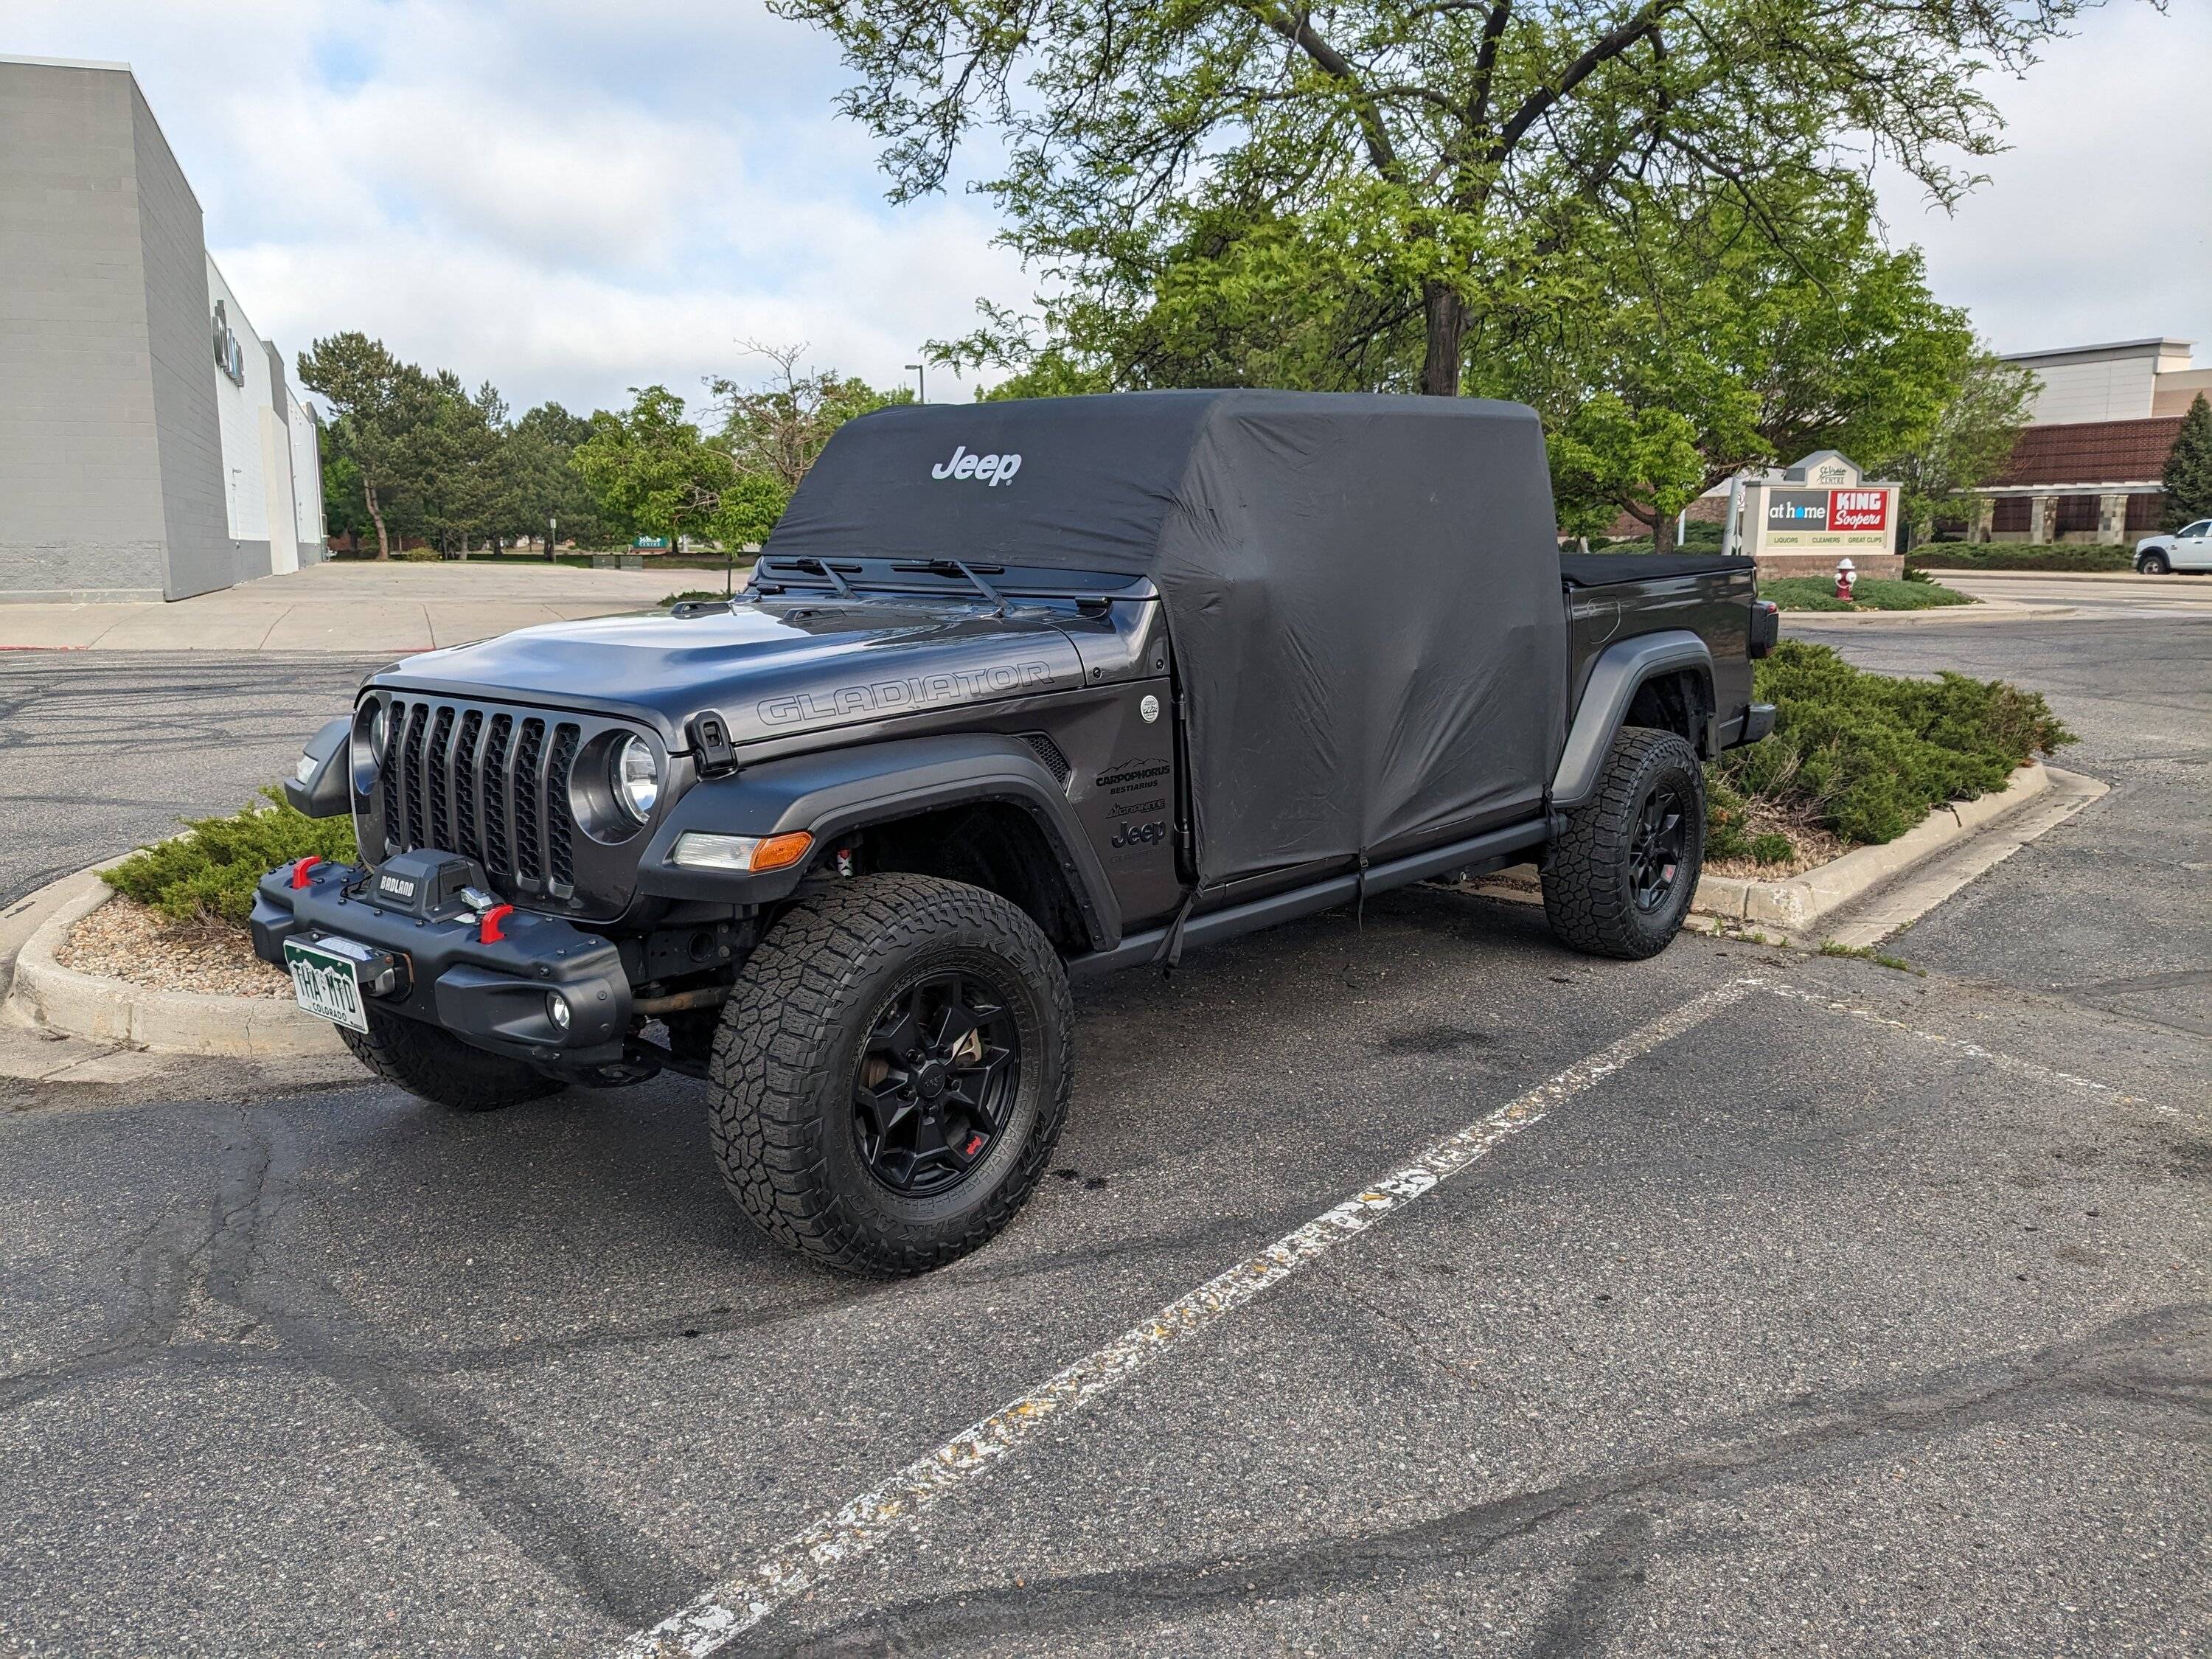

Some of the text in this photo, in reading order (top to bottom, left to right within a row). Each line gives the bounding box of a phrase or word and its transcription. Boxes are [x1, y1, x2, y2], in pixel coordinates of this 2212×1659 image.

[931, 445, 1023, 487] Jeep
[1770, 504, 1784, 519] at
[1836, 493, 1882, 510] KING
[1834, 509, 1882, 529] Soopers
[757, 660, 1055, 726] GLADIATOR
[1096, 765, 1171, 787] CARPOPHORUS
[1110, 779, 1158, 795] BESTIARIUS
[1110, 821, 1166, 849] Jeep
[380, 875, 414, 897] BADLAND
[313, 1003, 347, 1022] COLORADO
